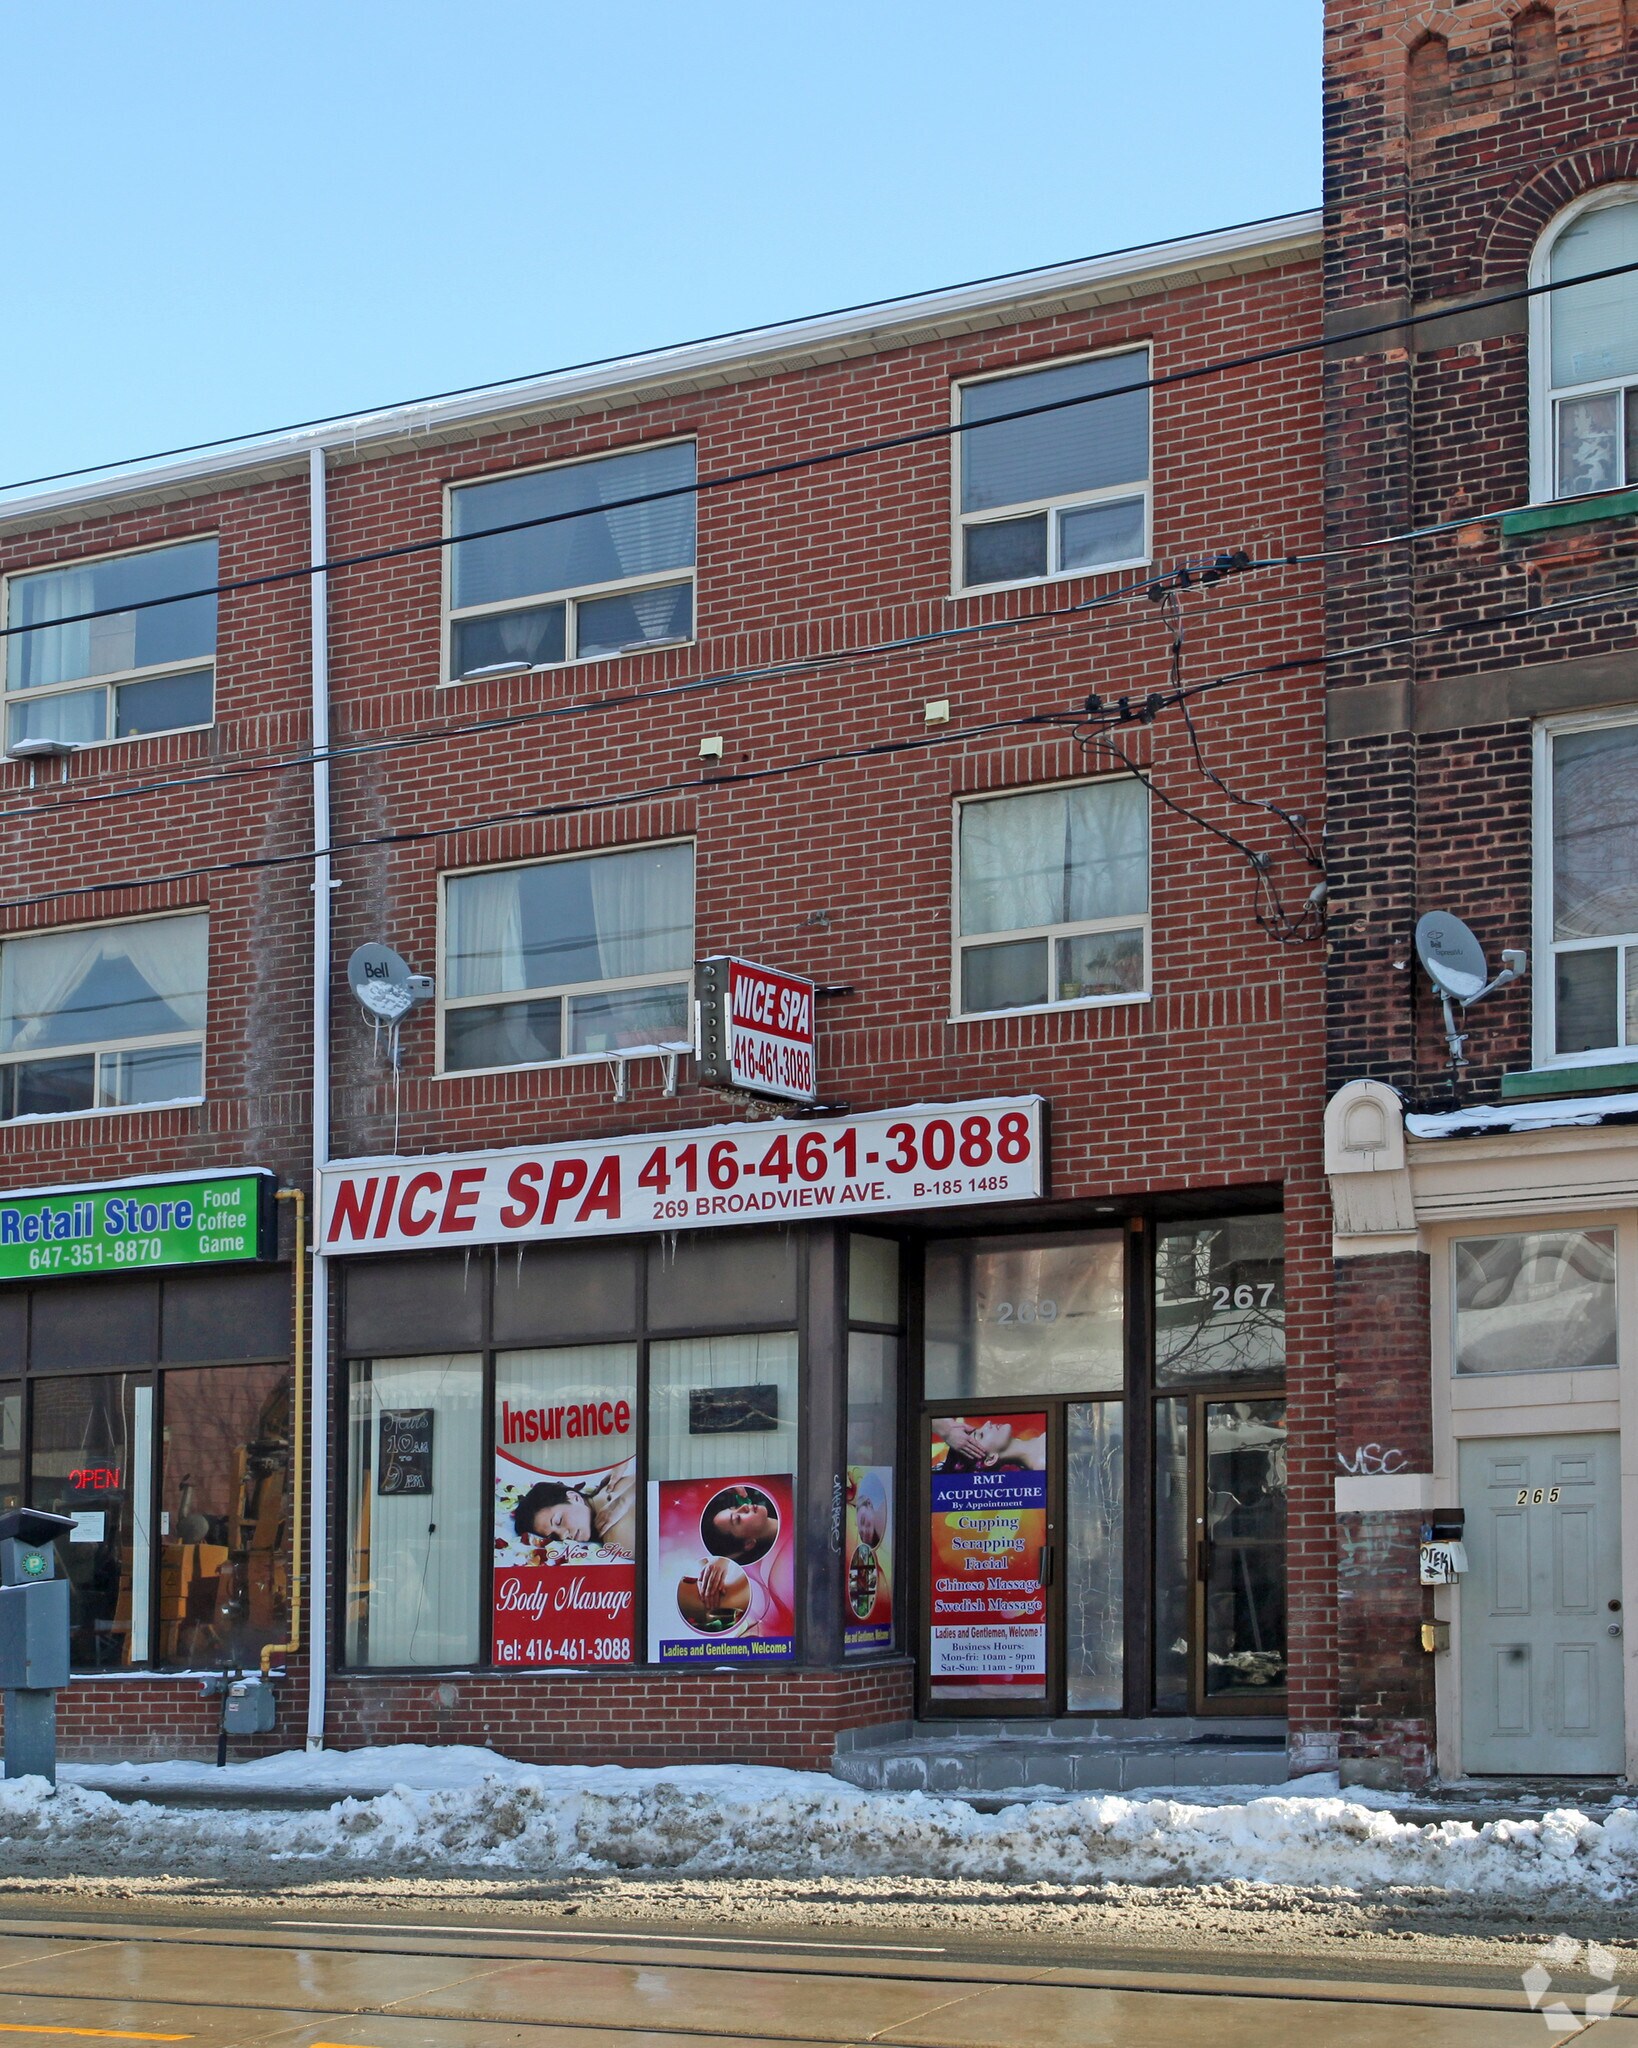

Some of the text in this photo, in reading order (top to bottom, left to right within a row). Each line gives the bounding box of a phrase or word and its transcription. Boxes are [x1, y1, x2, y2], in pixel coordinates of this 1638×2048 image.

[364, 962, 389, 978] Bell
[734, 975, 809, 1034] NICE SPA
[734, 1034, 811, 1092] 416-461-3088
[327, 1112, 1030, 1243] NICE SPA 416-461-3088
[203, 1188, 241, 1208] Food
[653, 1176, 1009, 1219] 269 BROADVIEW AVE. B-185 1485
[1, 1199, 193, 1245] Retail Store
[197, 1211, 247, 1231] Coffee
[29, 1238, 162, 1269] 647-351-8870
[199, 1235, 244, 1254] Game
[1212, 1283, 1276, 1310] 267
[997, 1300, 1057, 1325] 269
[502, 1400, 630, 1445] Insurance
[69, 1468, 120, 1489] OPEN
[973, 1474, 1006, 1485] RMT
[937, 1487, 1042, 1500] ACUPUNCTURE
[1517, 1488, 1560, 1505] 265
[952, 1500, 1023, 1510] By Appointment
[958, 1516, 1019, 1533] Cupping
[547, 1543, 632, 1562] Nice Spa
[952, 1536, 1025, 1553] Scrapping
[964, 1556, 1008, 1571] Facial
[936, 1578, 1041, 1593] Chinese Massage
[496, 1576, 632, 1621] Body Massage
[935, 1598, 1042, 1614] Swedish Massage
[935, 1628, 956, 1639] Ladies
[957, 1628, 969, 1638] and
[970, 1627, 1007, 1639] Gentlemen,
[1008, 1626, 1038, 1638] Welcome
[496, 1638, 631, 1661] Tel: 416-461-3088
[663, 1645, 688, 1656] Ladies
[690, 1645, 704, 1656] and
[706, 1643, 749, 1656] Gentlemen,
[751, 1641, 787, 1654] Welcome
[952, 1643, 1024, 1651] Business Hours:
[941, 1653, 979, 1661] Mon-fri:
[1015, 1653, 1036, 1663] 9pm
[941, 1664, 979, 1672] Sat-Sun:
[1015, 1664, 1036, 1673] 9pm
